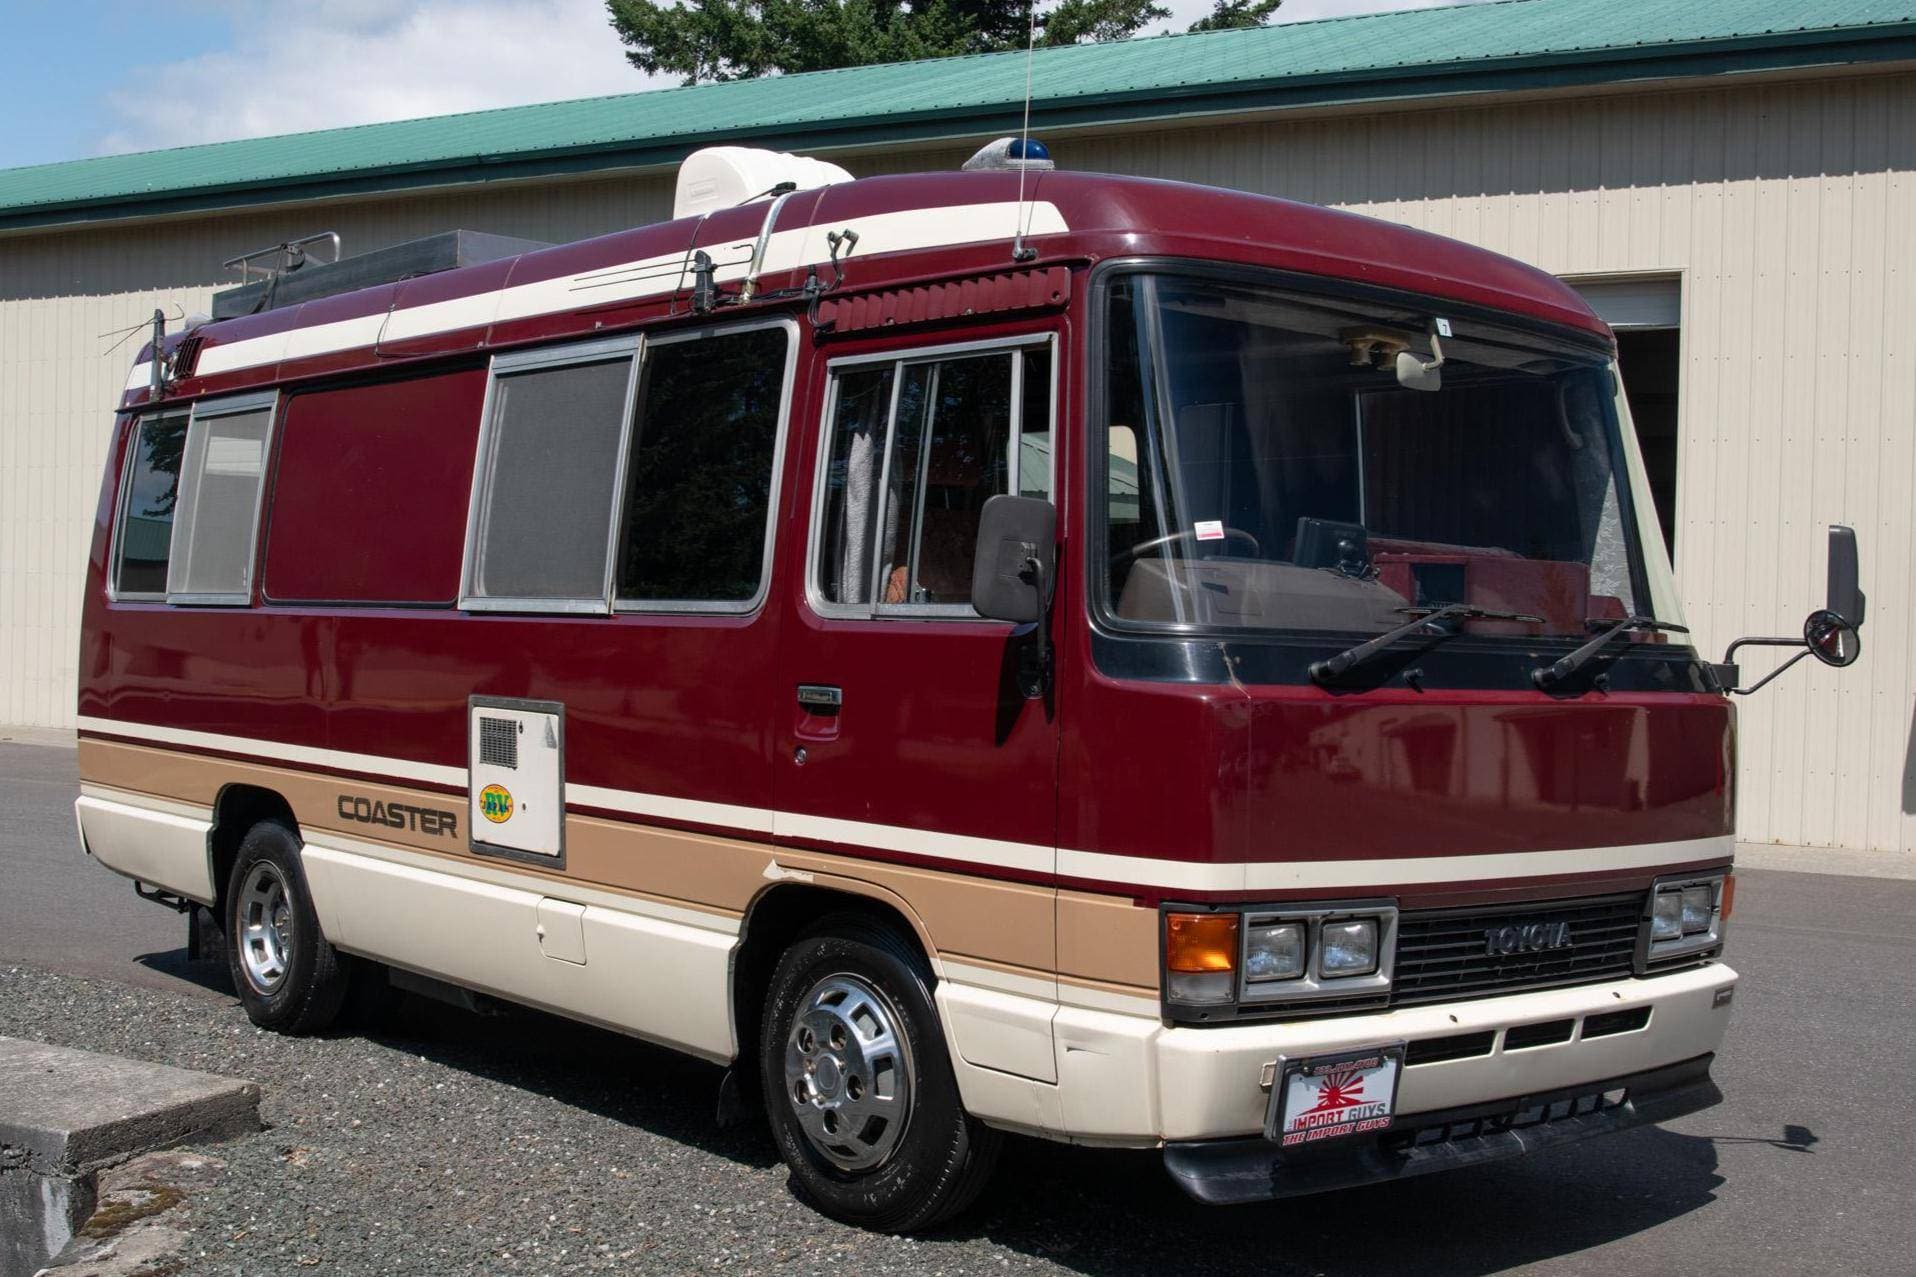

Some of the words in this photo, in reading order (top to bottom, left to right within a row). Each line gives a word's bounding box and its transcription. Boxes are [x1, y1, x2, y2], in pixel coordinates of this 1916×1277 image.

[337, 795, 458, 838] COASTER
[1485, 921, 1573, 955] TOYOTA
[1283, 1131, 1307, 1146] THE
[1306, 1122, 1356, 1141] IMPORT
[1356, 1116, 1391, 1131] GUYS
[1294, 1110, 1344, 1131] IMPORT
[1348, 1103, 1386, 1120] GUYS
